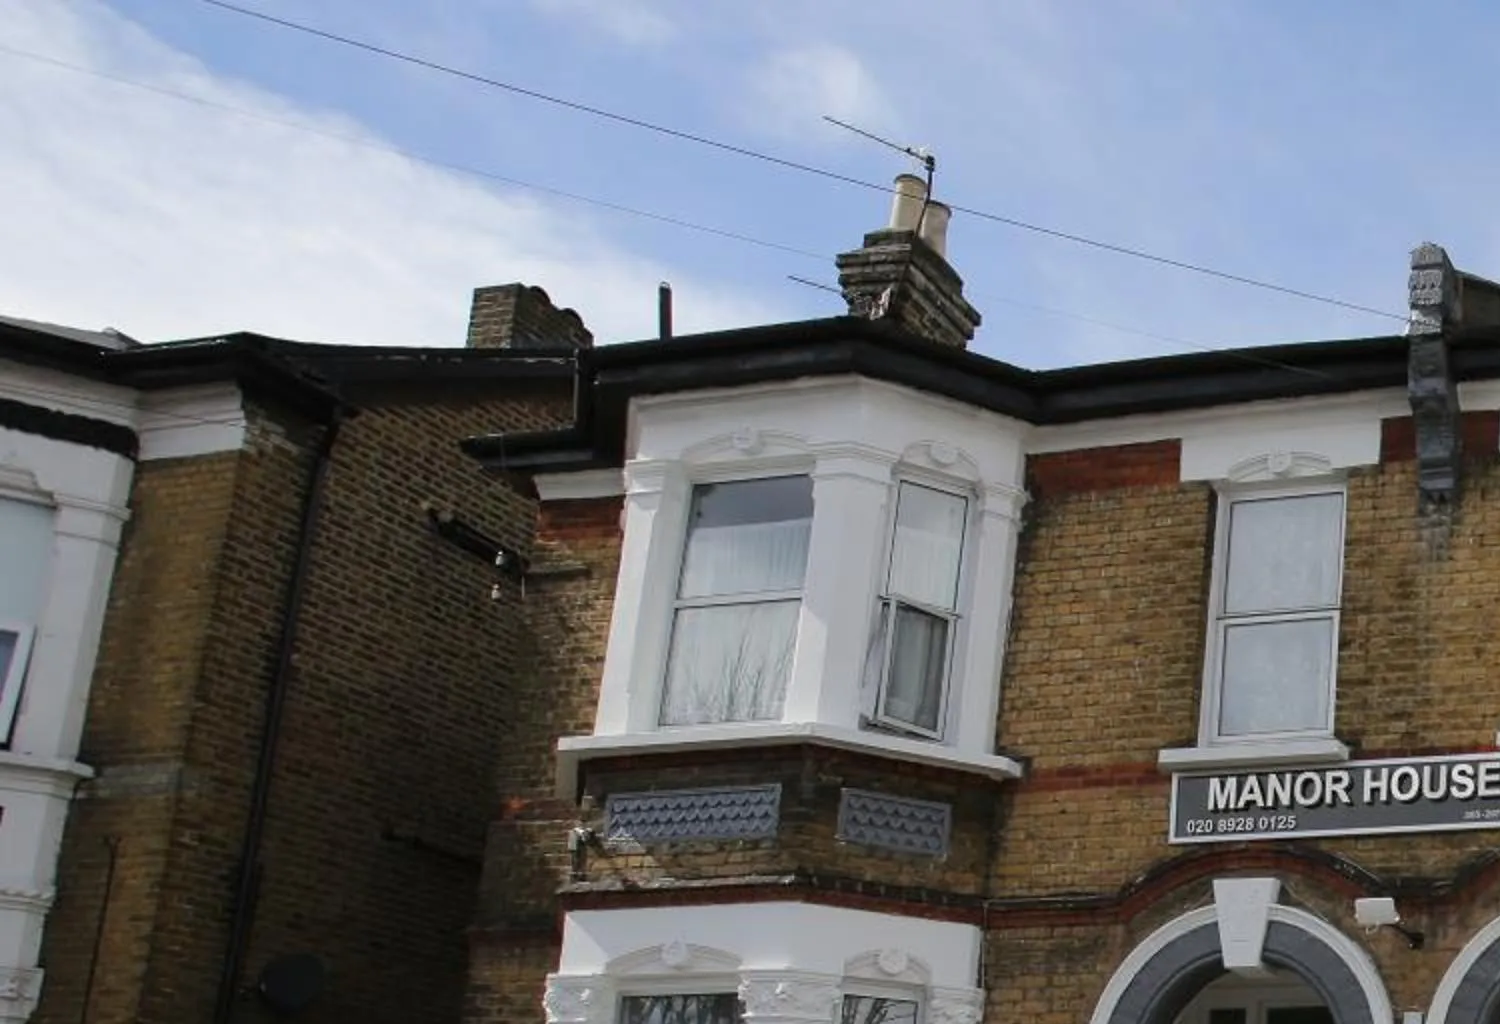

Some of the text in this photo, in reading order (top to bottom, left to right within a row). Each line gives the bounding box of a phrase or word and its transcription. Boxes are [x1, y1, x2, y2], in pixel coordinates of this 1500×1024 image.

[1207, 770, 1351, 811] MANOR
[1187, 815, 1297, 833] 020 8928 0125
